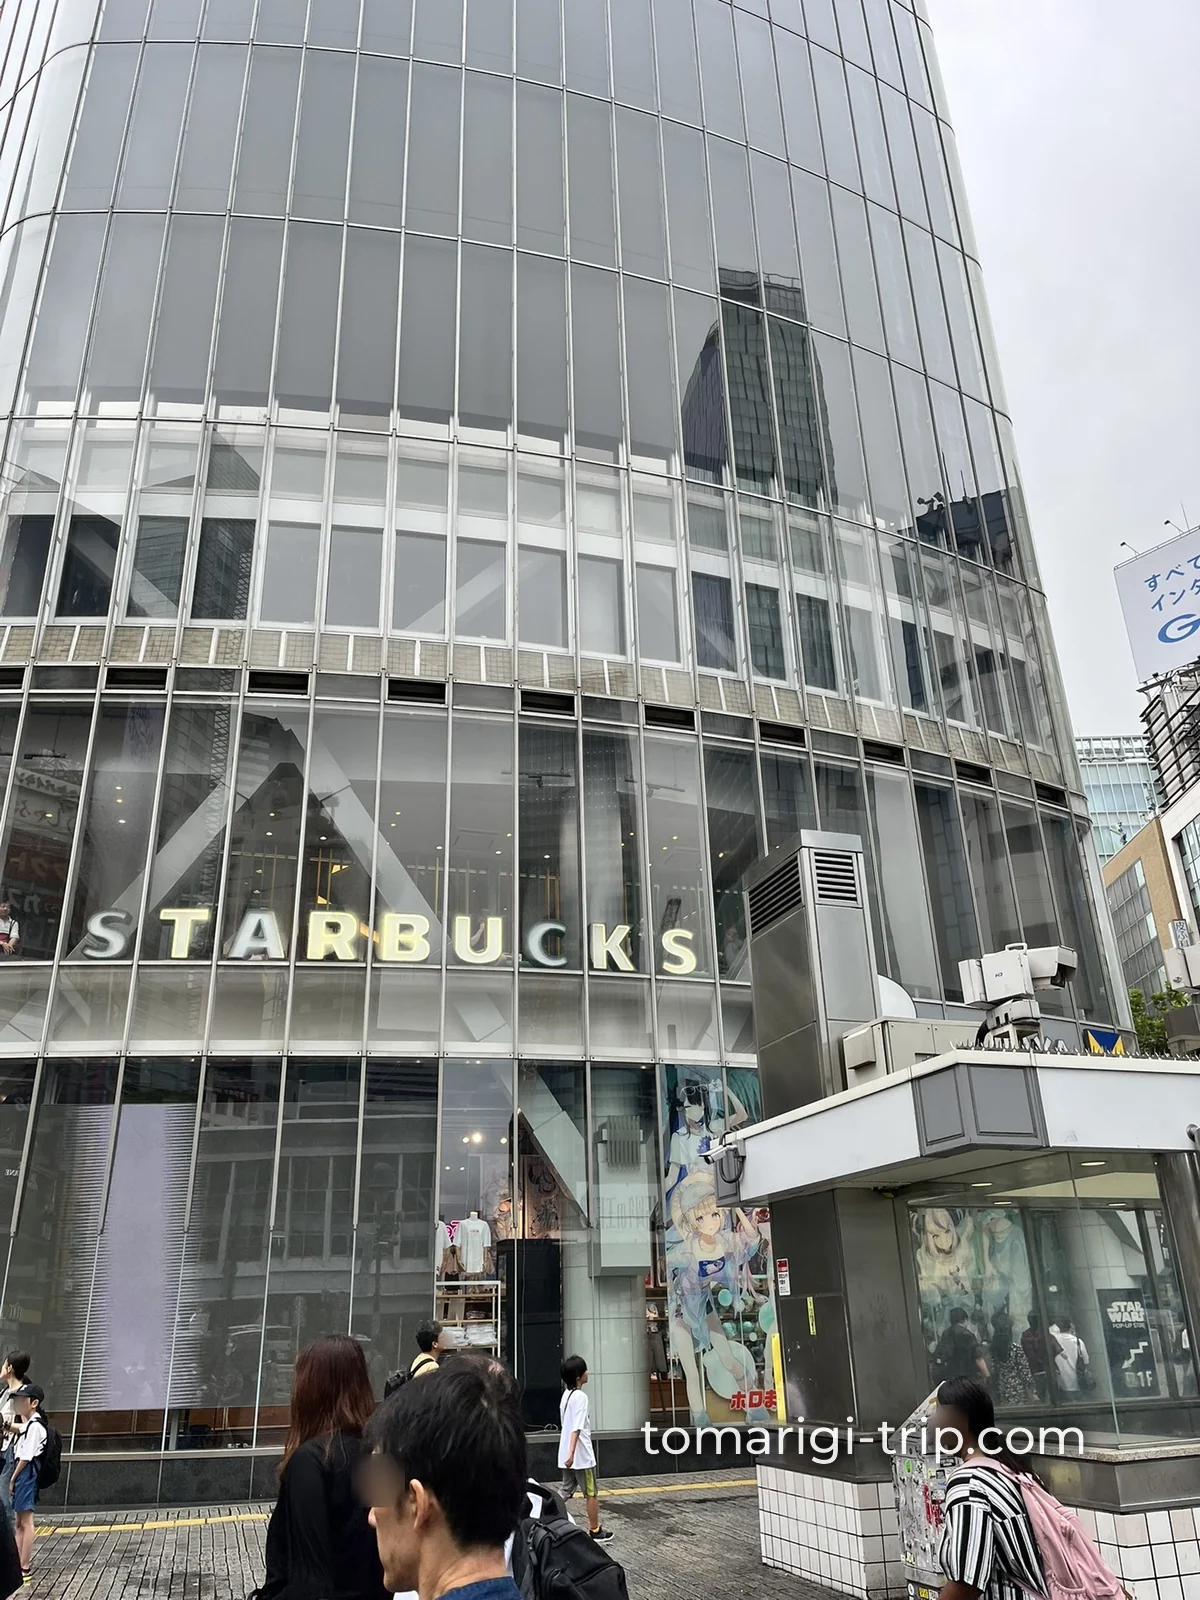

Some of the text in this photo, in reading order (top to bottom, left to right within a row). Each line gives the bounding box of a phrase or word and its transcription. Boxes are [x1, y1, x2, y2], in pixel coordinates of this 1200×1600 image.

[84, 906, 698, 976] STARBUCKS
[1106, 1301, 1144, 1312] STAR
[1107, 1311, 1145, 1323] WARS
